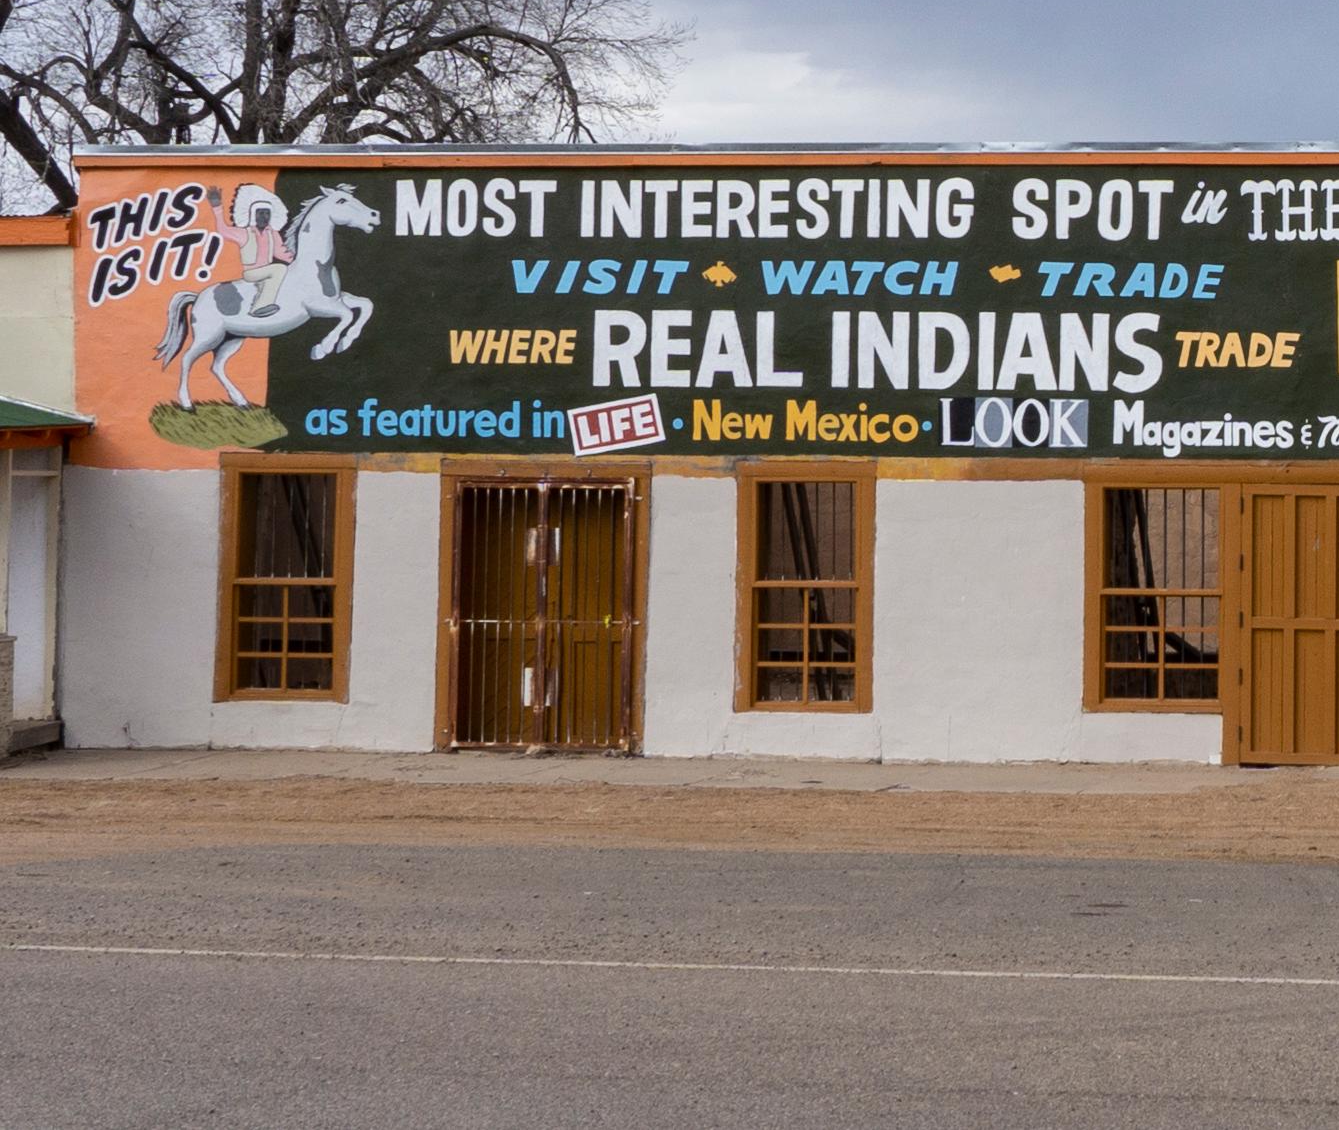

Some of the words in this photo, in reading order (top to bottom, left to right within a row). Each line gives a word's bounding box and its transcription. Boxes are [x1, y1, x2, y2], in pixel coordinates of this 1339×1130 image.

[88, 183, 205, 253] THIS
[395, 178, 557, 237] MOST
[579, 177, 975, 239] INTERESTING
[1012, 178, 1173, 241] SPOT
[1181, 182, 1228, 225] in
[88, 251, 137, 306] IS
[146, 230, 223, 281] IT!
[511, 259, 690, 294] VISIT
[761, 260, 959, 296] WATCH
[1037, 261, 1225, 300] TRADE
[449, 329, 577, 364] WHERE
[592, 309, 803, 388] REAL
[831, 311, 1163, 394] INDIANS
[1174, 330, 1301, 368] TRADE
[305, 407, 348, 437] as
[358, 398, 521, 438] featured
[532, 398, 565, 439] in
[575, 403, 658, 448] LIFE
[693, 398, 772, 442] New
[785, 398, 919, 443] Mexico
[941, 397, 1088, 447] LOOK
[1113, 400, 1293, 457] Magazines
